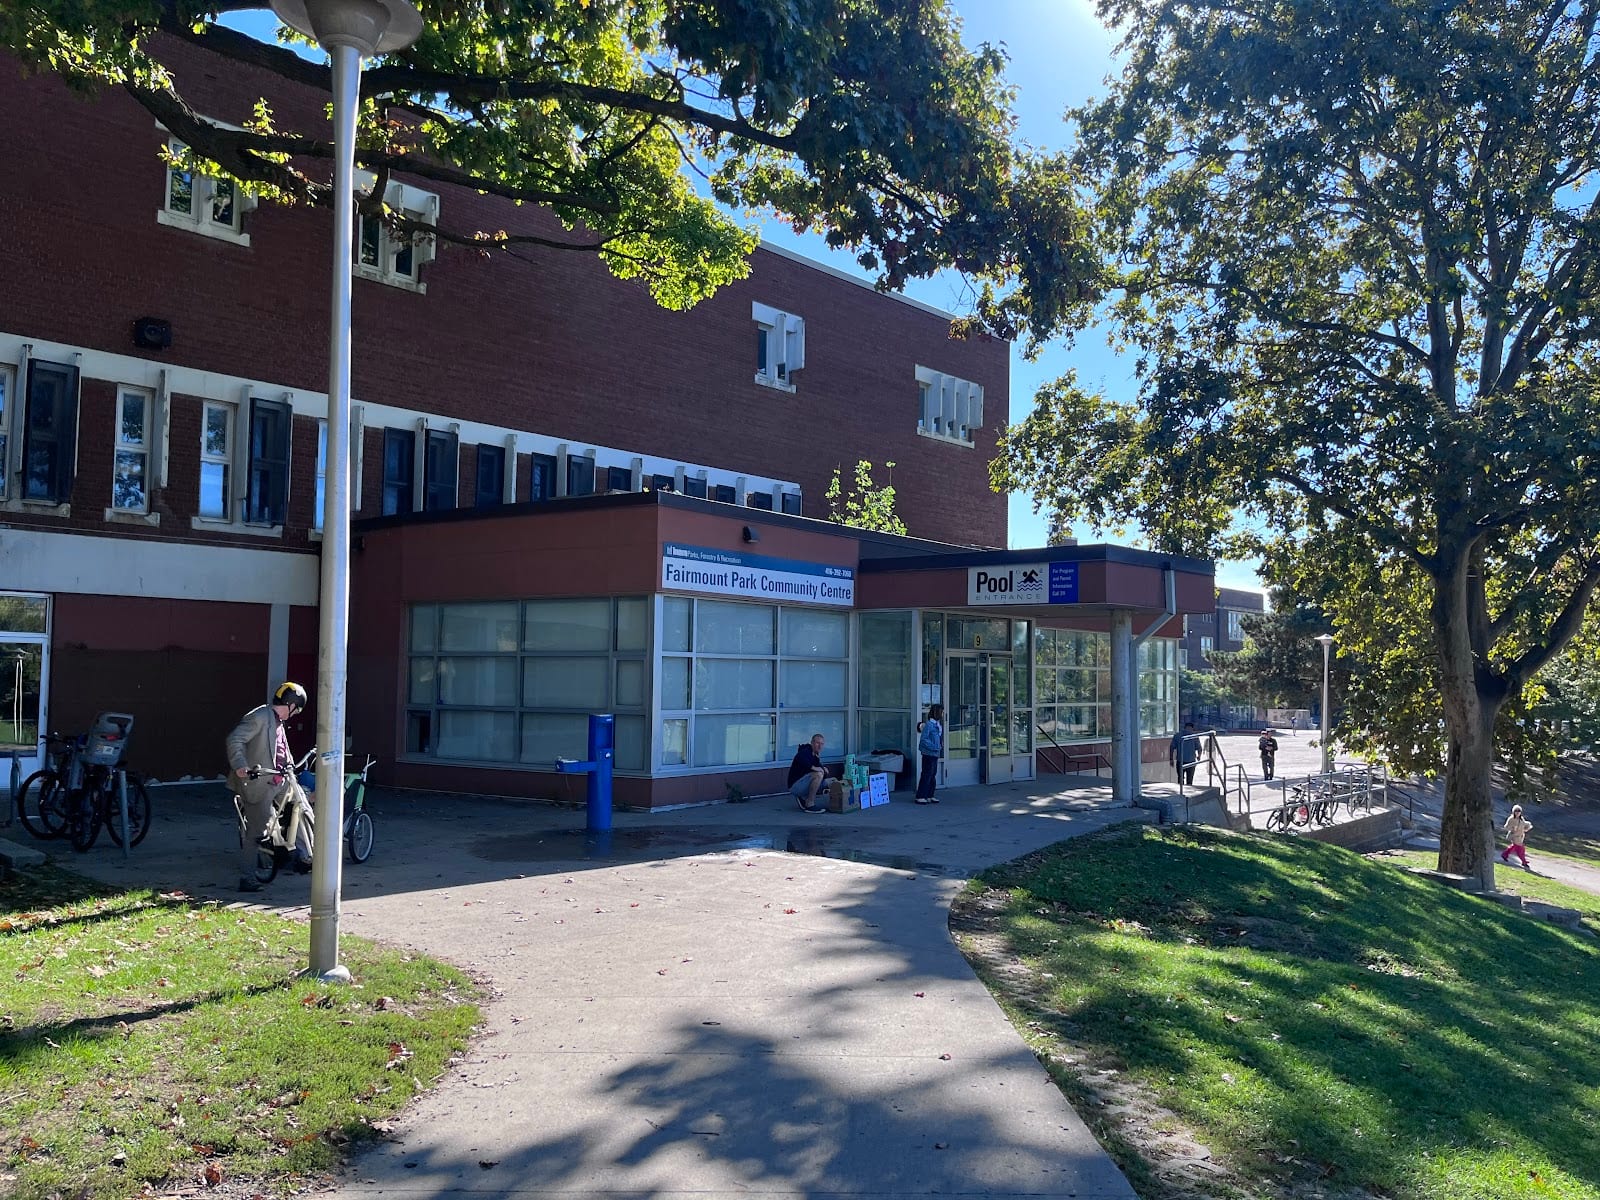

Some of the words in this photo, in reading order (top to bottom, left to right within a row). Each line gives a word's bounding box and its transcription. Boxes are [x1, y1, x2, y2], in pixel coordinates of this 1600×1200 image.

[666, 564, 728, 588] Fairmount
[731, 571, 756, 590] Park
[761, 575, 818, 600] Community
[820, 582, 852, 600] Centre
[977, 570, 1013, 593] Pool
[976, 635, 981, 646] 9
